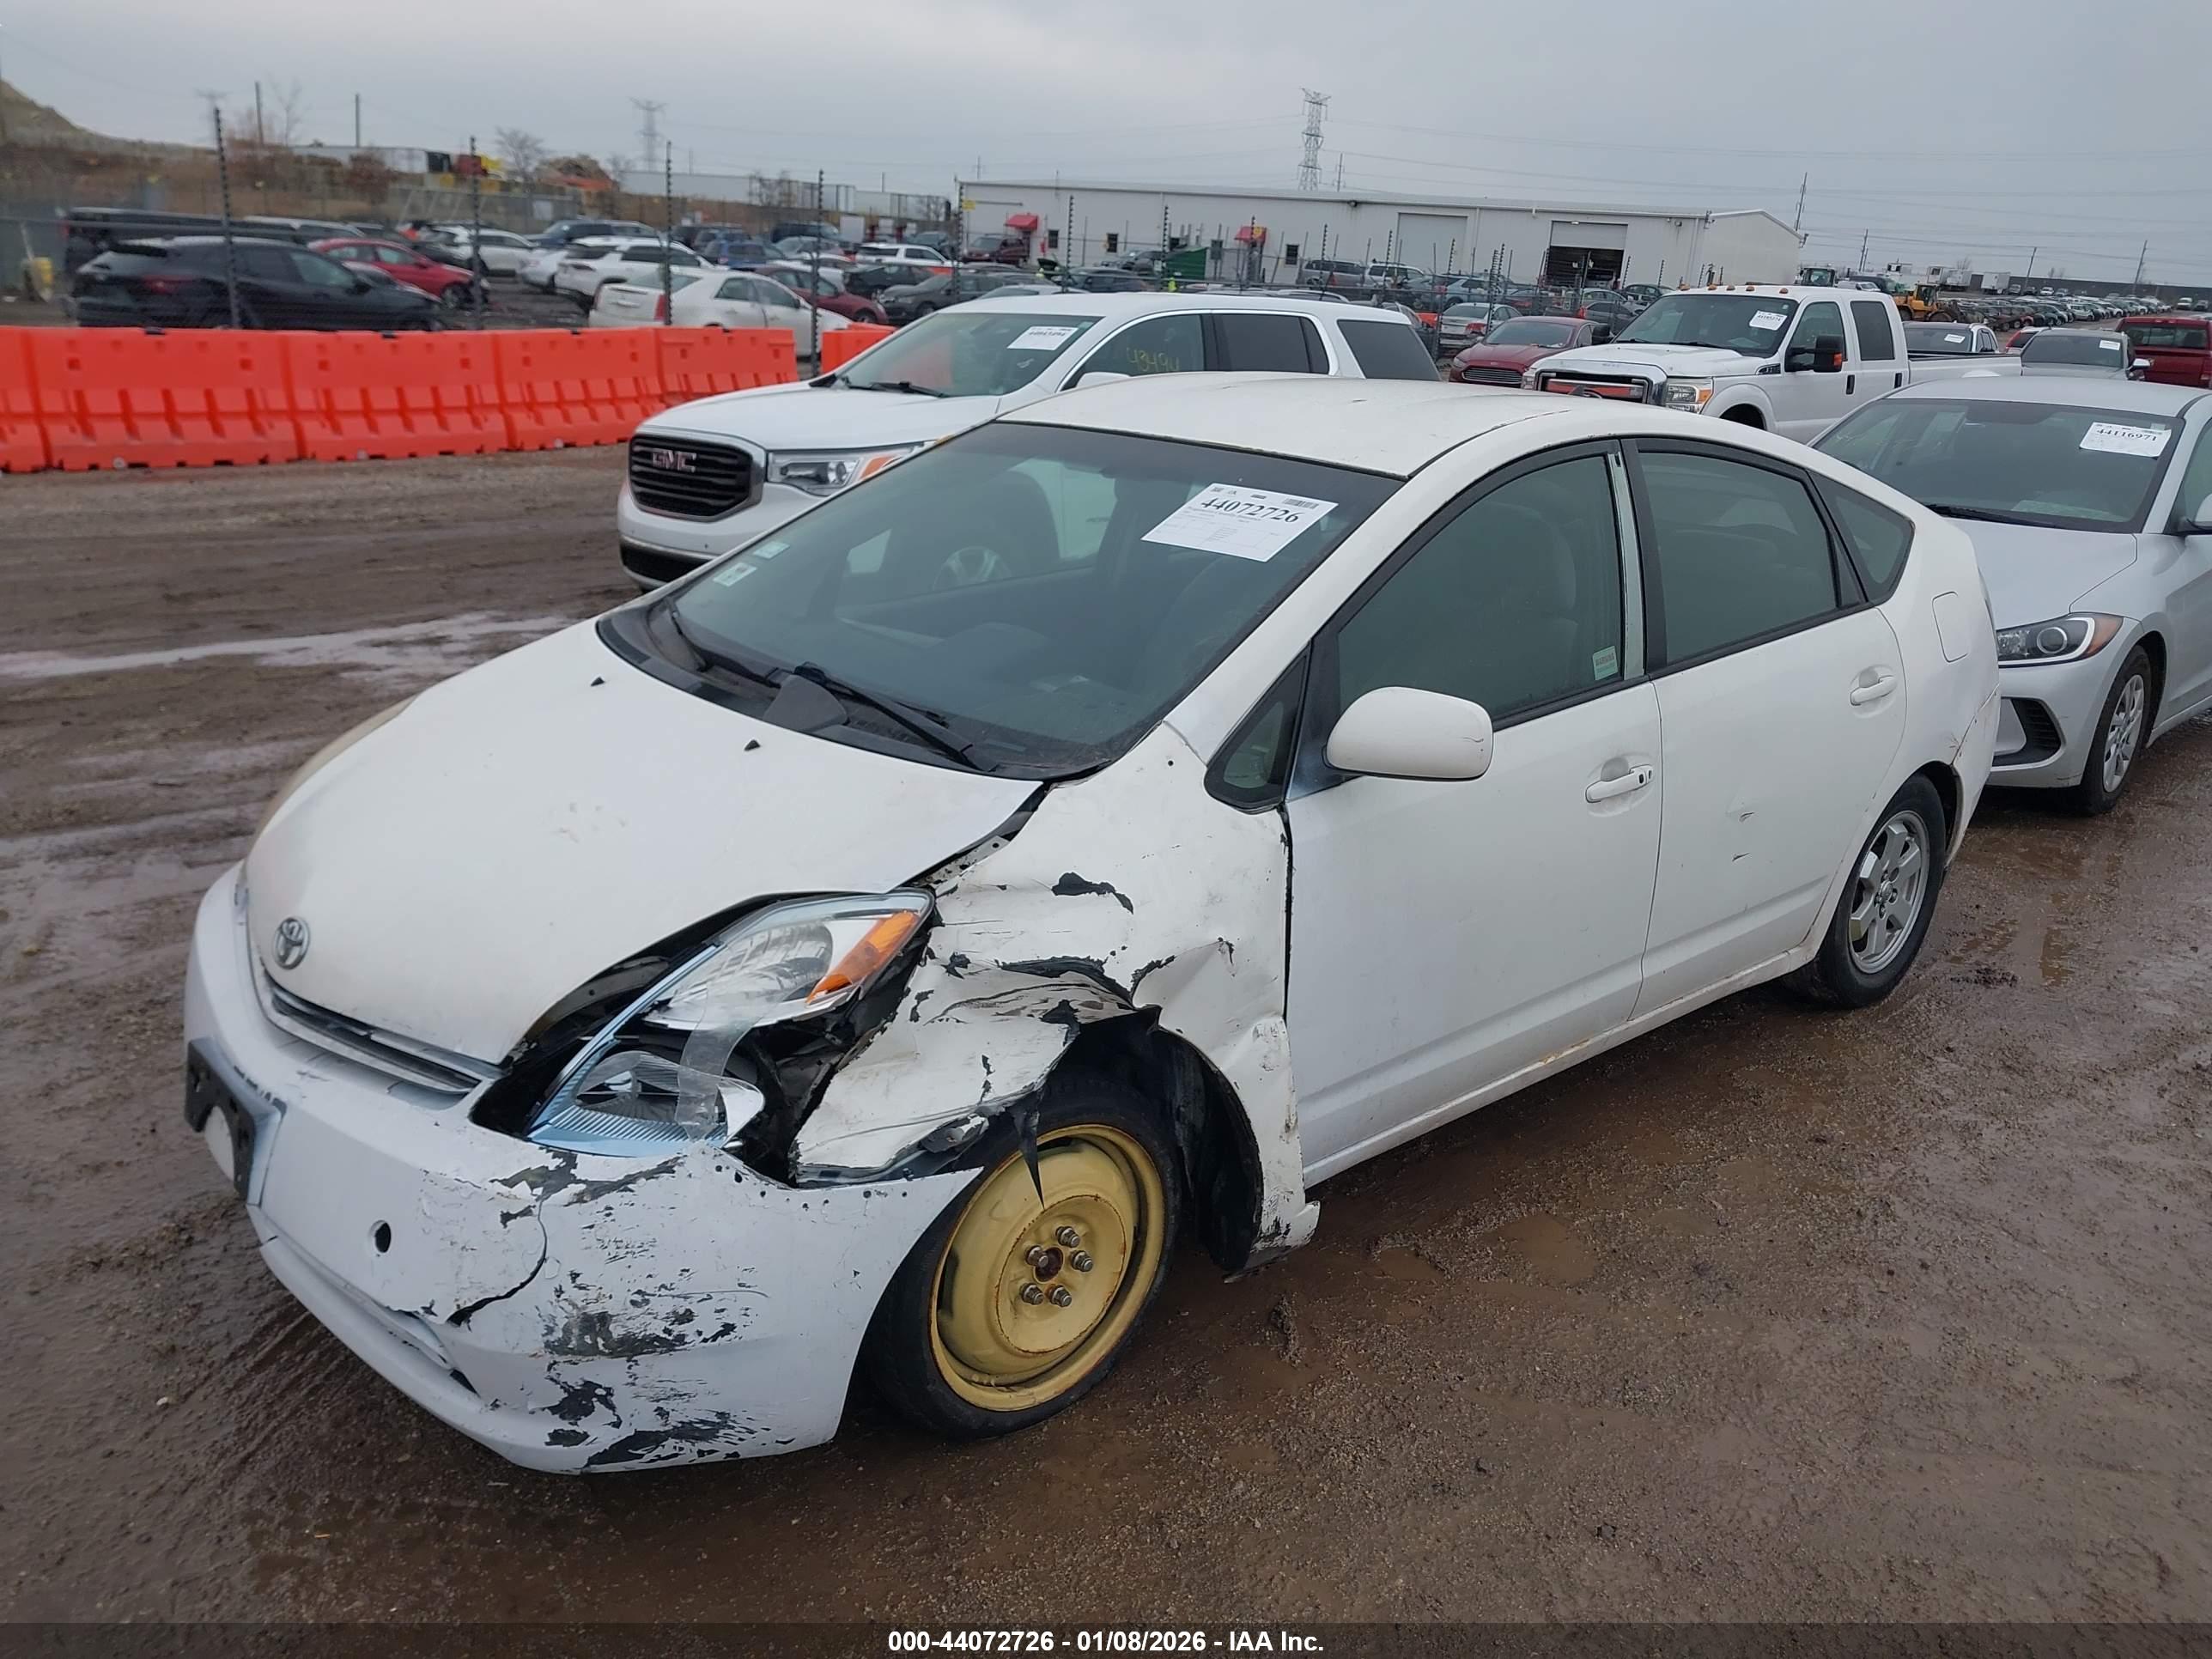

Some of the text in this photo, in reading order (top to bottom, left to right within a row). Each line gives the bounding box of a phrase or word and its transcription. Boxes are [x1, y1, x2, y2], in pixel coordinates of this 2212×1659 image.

[2097, 429, 2157, 441] 44116971
[653, 448, 697, 472] GMC
[1201, 498, 1304, 523] 44072726
